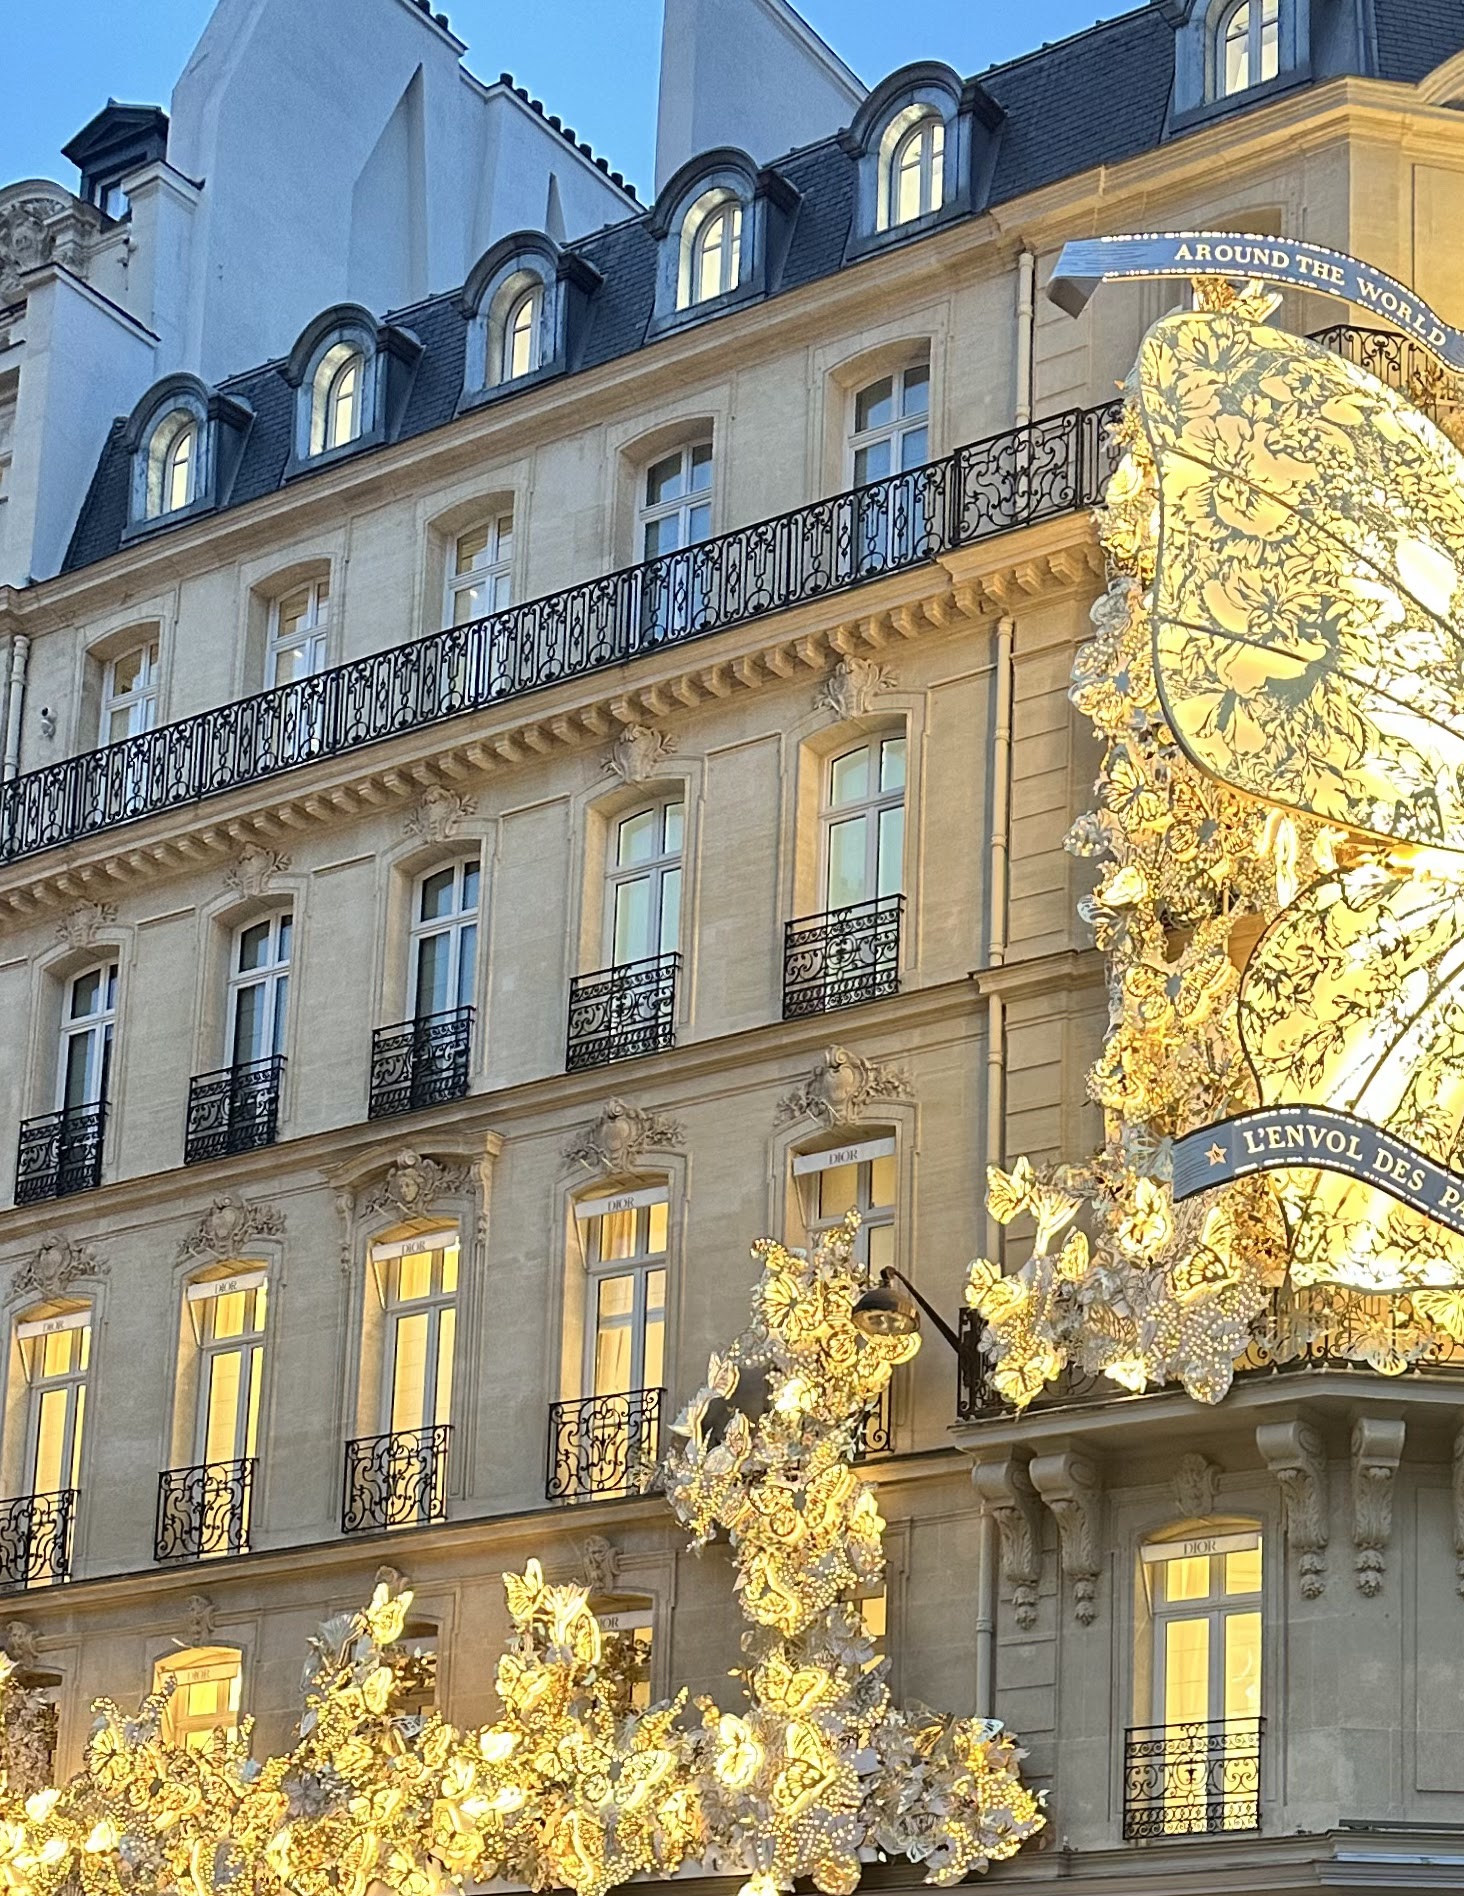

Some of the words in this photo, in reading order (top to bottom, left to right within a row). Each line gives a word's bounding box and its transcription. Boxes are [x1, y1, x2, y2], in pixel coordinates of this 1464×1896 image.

[1174, 241, 1289, 269] AROUND
[1296, 254, 1346, 286] THE
[1356, 276, 1446, 348] WORLD
[829, 1150, 858, 1165] DIOR
[1243, 1124, 1363, 1161] L'ENVOL
[1374, 1148, 1424, 1191] DES
[607, 1197, 635, 1211] DIOR
[402, 1240, 426, 1254] DIOR
[1184, 1540, 1217, 1555] DIOR
